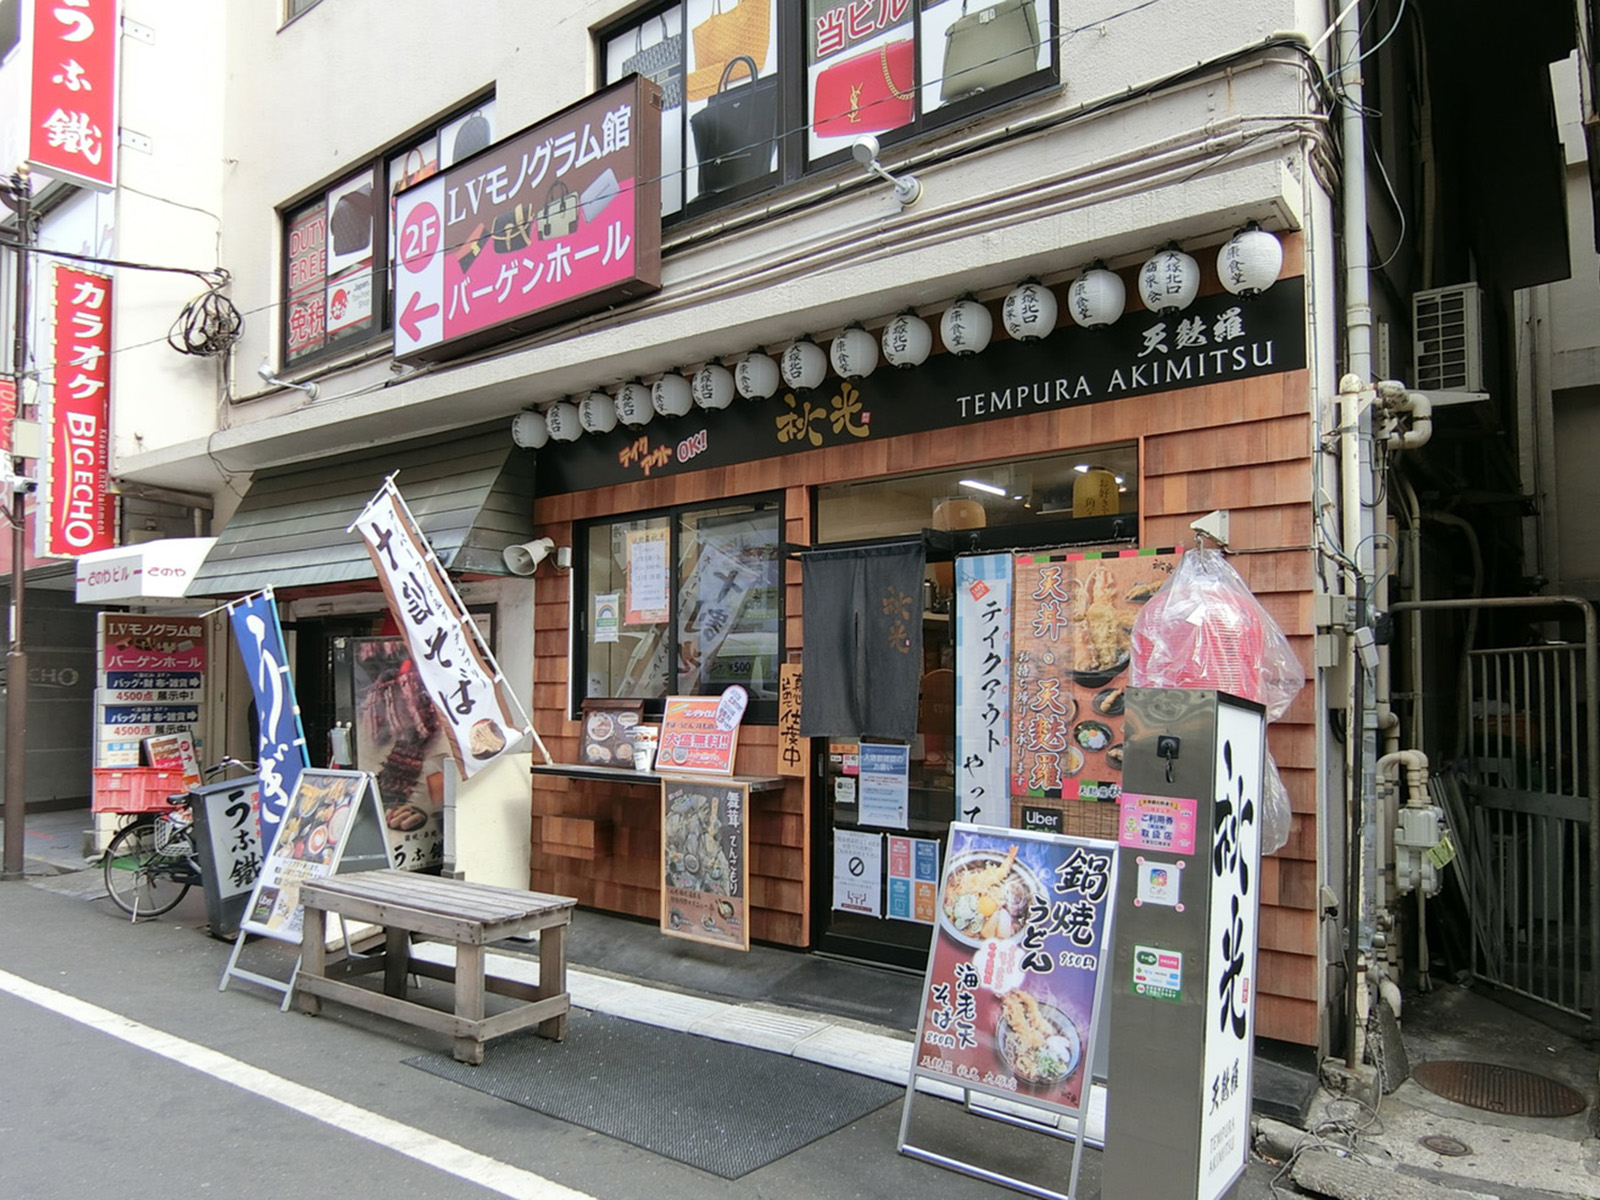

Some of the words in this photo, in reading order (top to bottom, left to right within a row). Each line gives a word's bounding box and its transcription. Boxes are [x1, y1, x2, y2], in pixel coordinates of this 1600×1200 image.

[446, 105, 632, 226] LVモノグラム館
[290, 217, 326, 258] DUTY
[405, 215, 436, 259] 2F
[289, 249, 326, 289] FREE
[448, 221, 631, 320] バーゲンホール
[1165, 252, 1182, 294] 大塚北口
[1021, 285, 1039, 324] 大塚北口
[69, 281, 106, 399] カラオケ
[956, 375, 1092, 418] TEMPURA
[1107, 340, 1274, 393] AKIMITSU
[66, 411, 97, 467] BIG
[775, 382, 870, 447] 秋光
[676, 429, 708, 463] OK!
[65, 471, 95, 547] ECHO
[108, 623, 203, 637] LVモノグラム館
[370, 522, 476, 726] 十割そば
[108, 655, 202, 668] バーゲンホール
[981, 601, 1003, 753] テイクアウト
[1026, 811, 1058, 826] Uber
[1049, 849, 1108, 947] 鍋焼
[1213, 739, 1254, 1040] 秋光
[1021, 895, 1053, 972] うどん
[1059, 951, 1096, 970] 950円
[931, 982, 953, 1030] そば
[954, 962, 979, 1049] 海老天
